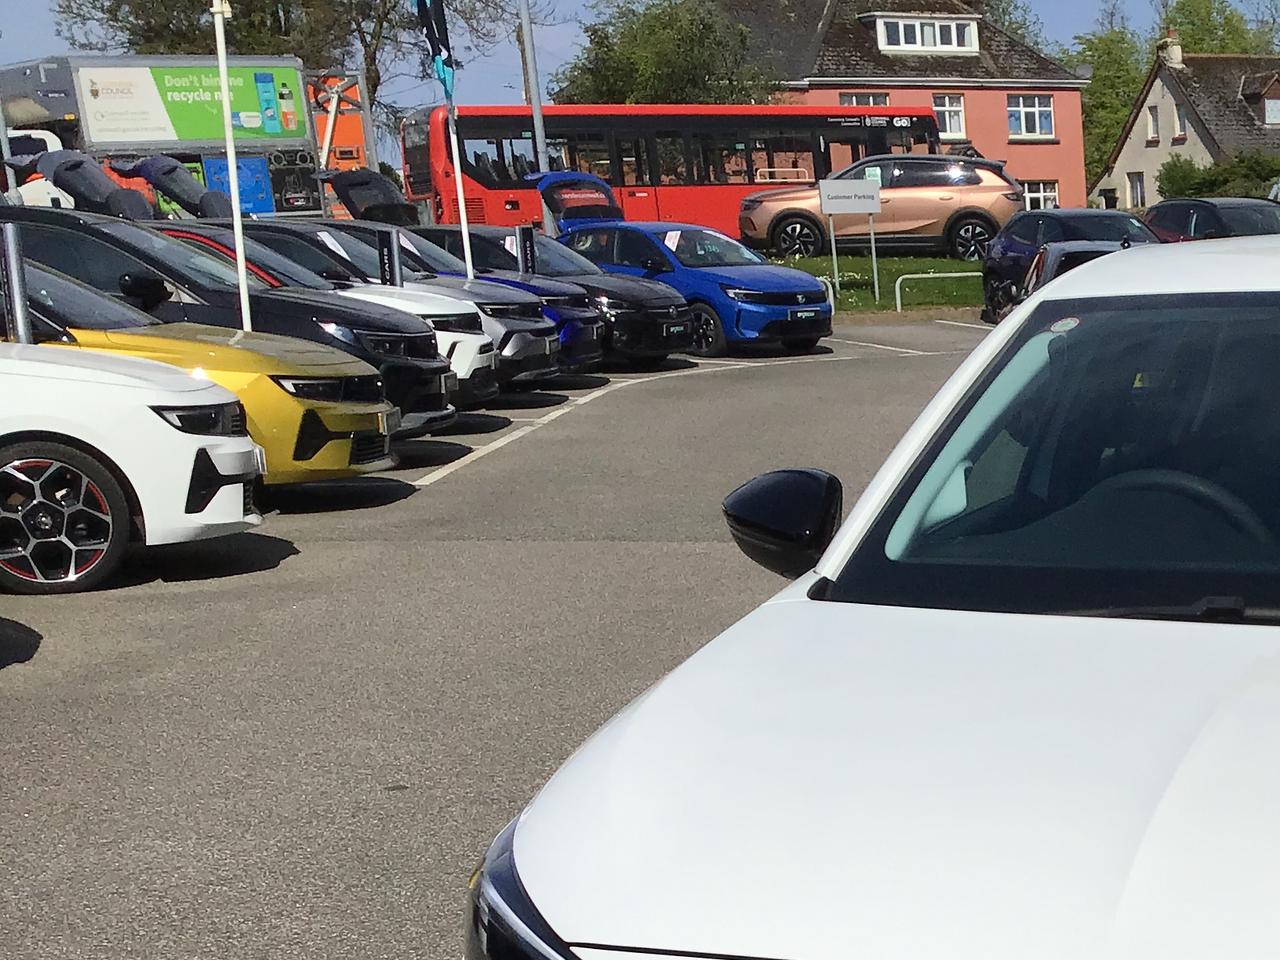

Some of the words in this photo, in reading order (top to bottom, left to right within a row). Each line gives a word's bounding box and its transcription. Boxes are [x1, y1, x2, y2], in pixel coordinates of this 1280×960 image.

[164, 74, 200, 87] Don't
[166, 88, 212, 104] recycle
[854, 193, 875, 201] Parking
